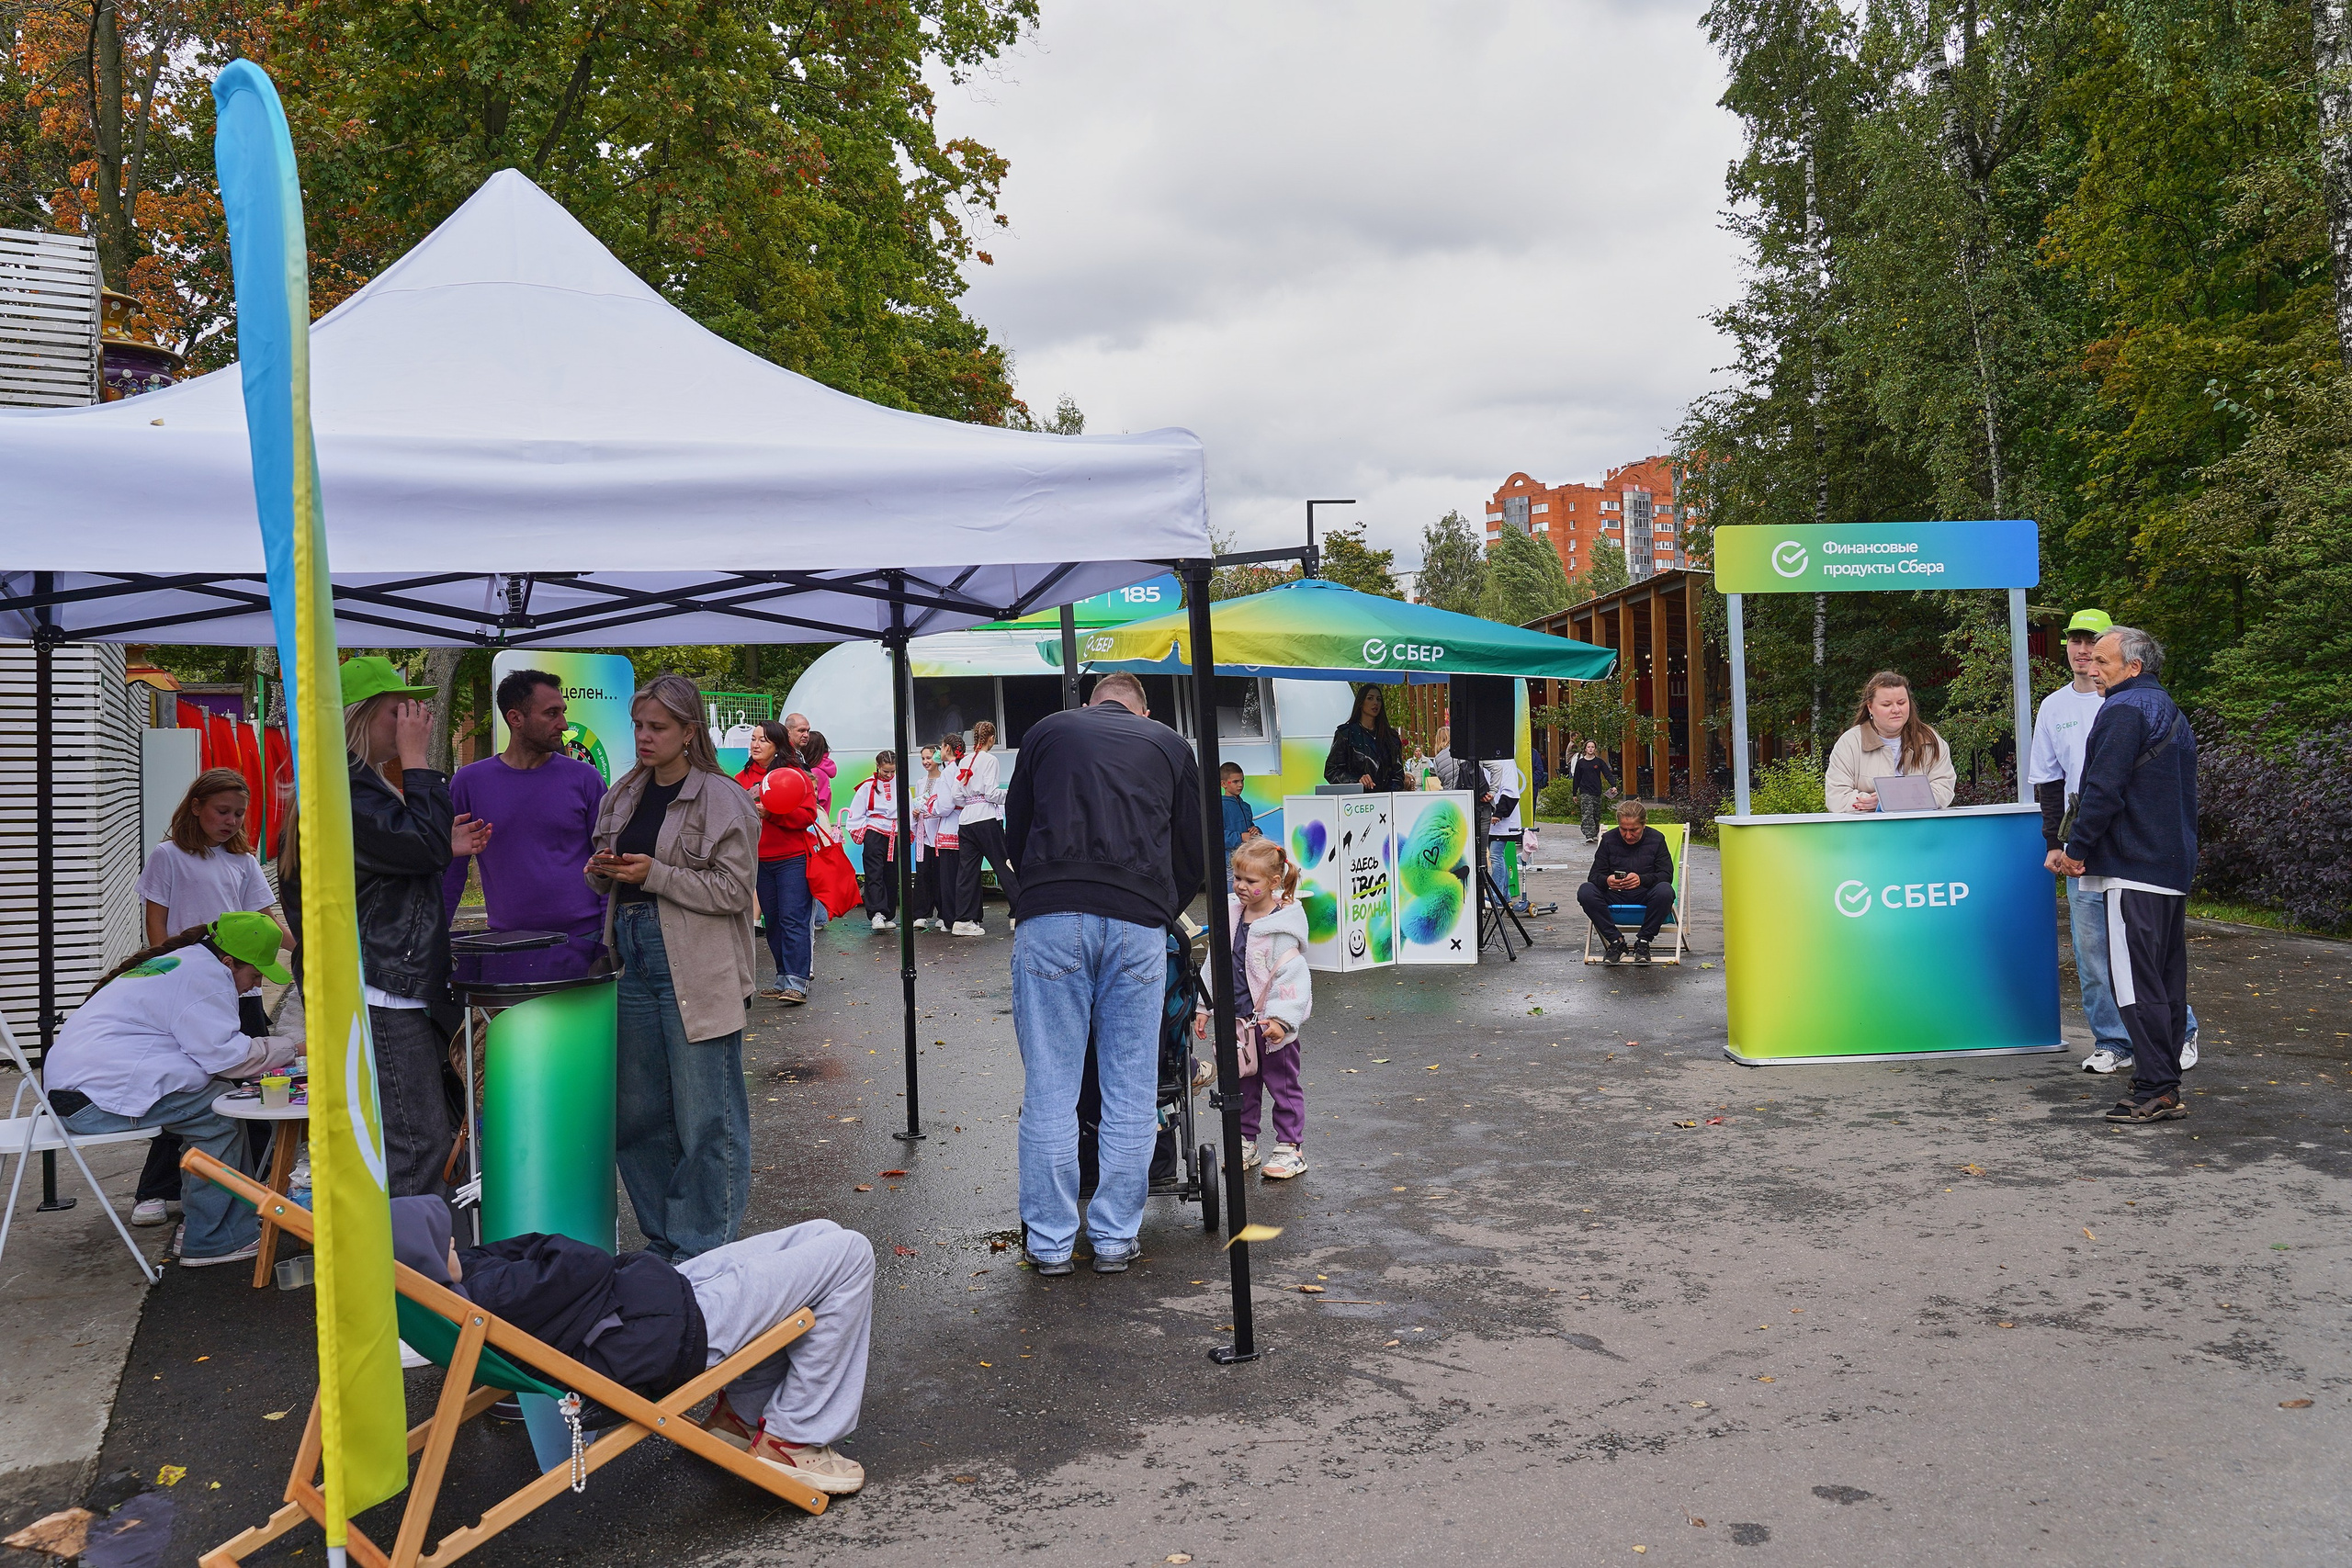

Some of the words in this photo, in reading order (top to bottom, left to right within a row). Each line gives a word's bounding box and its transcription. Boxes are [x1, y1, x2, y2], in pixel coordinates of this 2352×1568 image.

[1822, 540, 1918, 555] Финансовые
[1823, 563, 1895, 578] продукты
[1897, 558, 1945, 576] Сбера
[1120, 586, 1161, 603] 185
[1091, 637, 1114, 652] СБЕР
[1392, 643, 1444, 662] СБЕР
[2062, 720, 2077, 729] СБЕР
[599, 756, 607, 779] работу
[1354, 804, 1374, 814] СБЕР
[1350, 856, 1379, 873] ЗДЕСЬ
[1351, 873, 1388, 899] ТВОЯ
[1881, 882, 1970, 909] СБЕР
[1351, 900, 1389, 922] ВОЛНА
